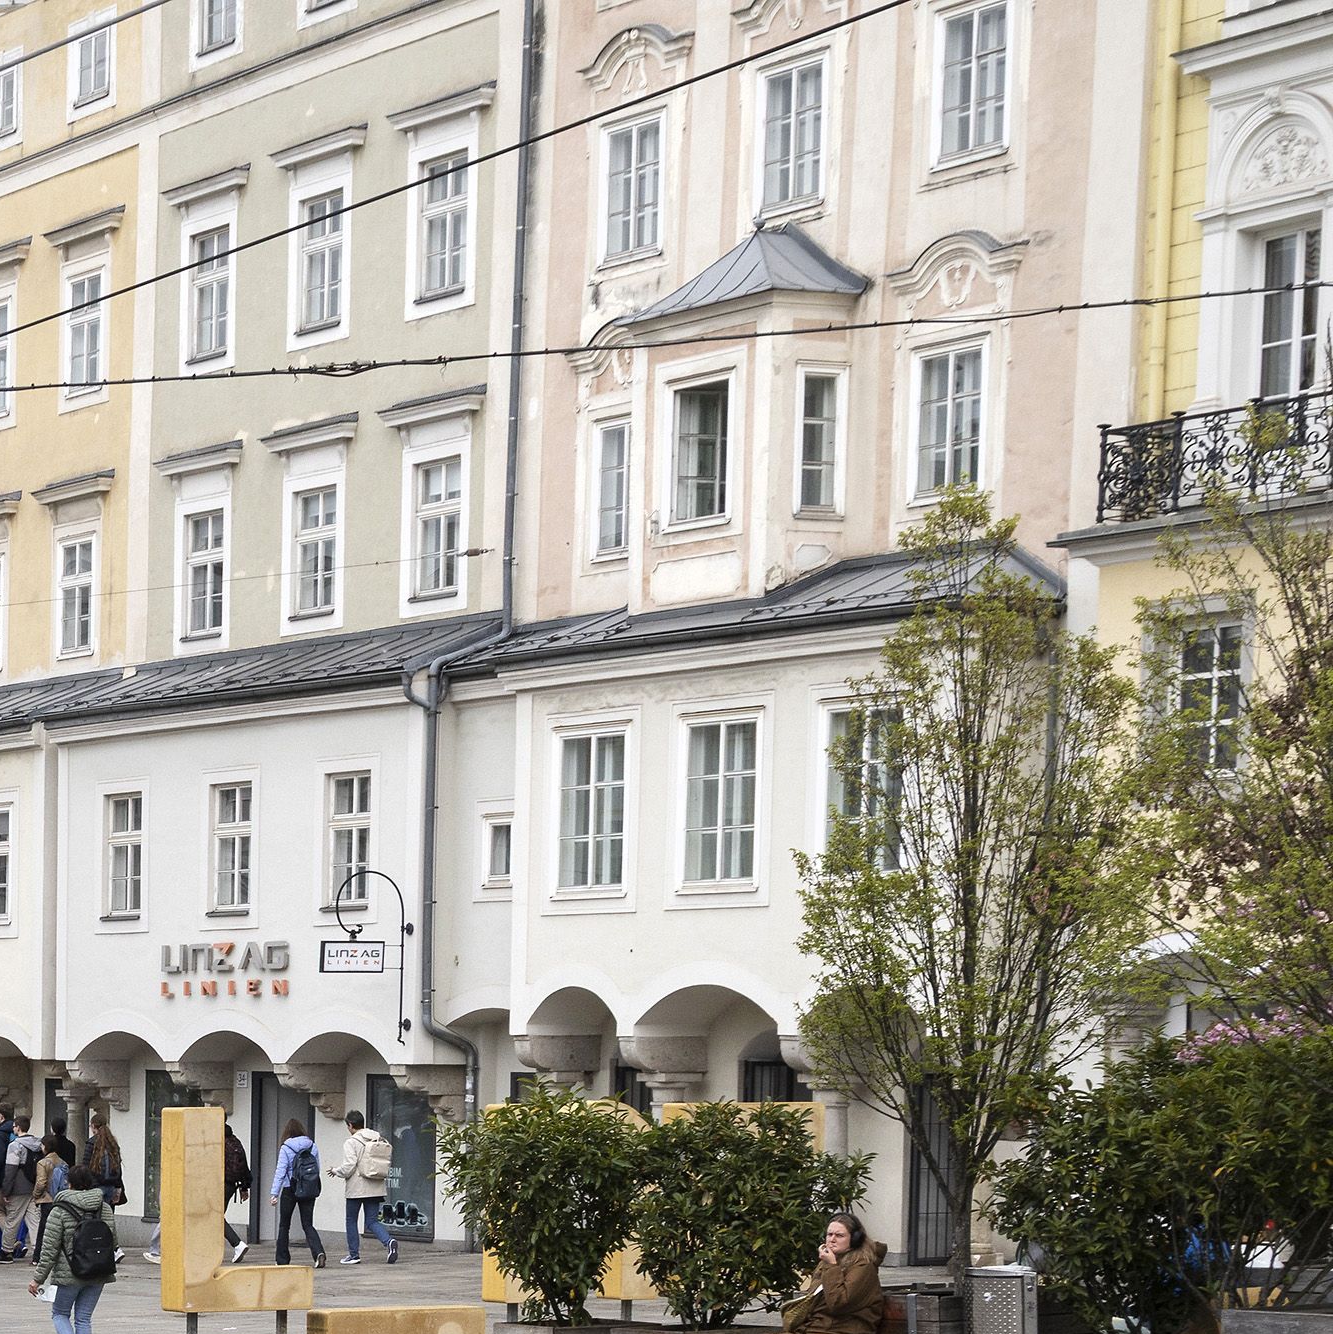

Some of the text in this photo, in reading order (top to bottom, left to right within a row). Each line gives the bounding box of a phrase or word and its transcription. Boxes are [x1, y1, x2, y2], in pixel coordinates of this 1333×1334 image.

[161, 940, 290, 973] LINZ AG
[327, 949, 381, 958] LINZ AG
[161, 979, 289, 998] LINIEN
